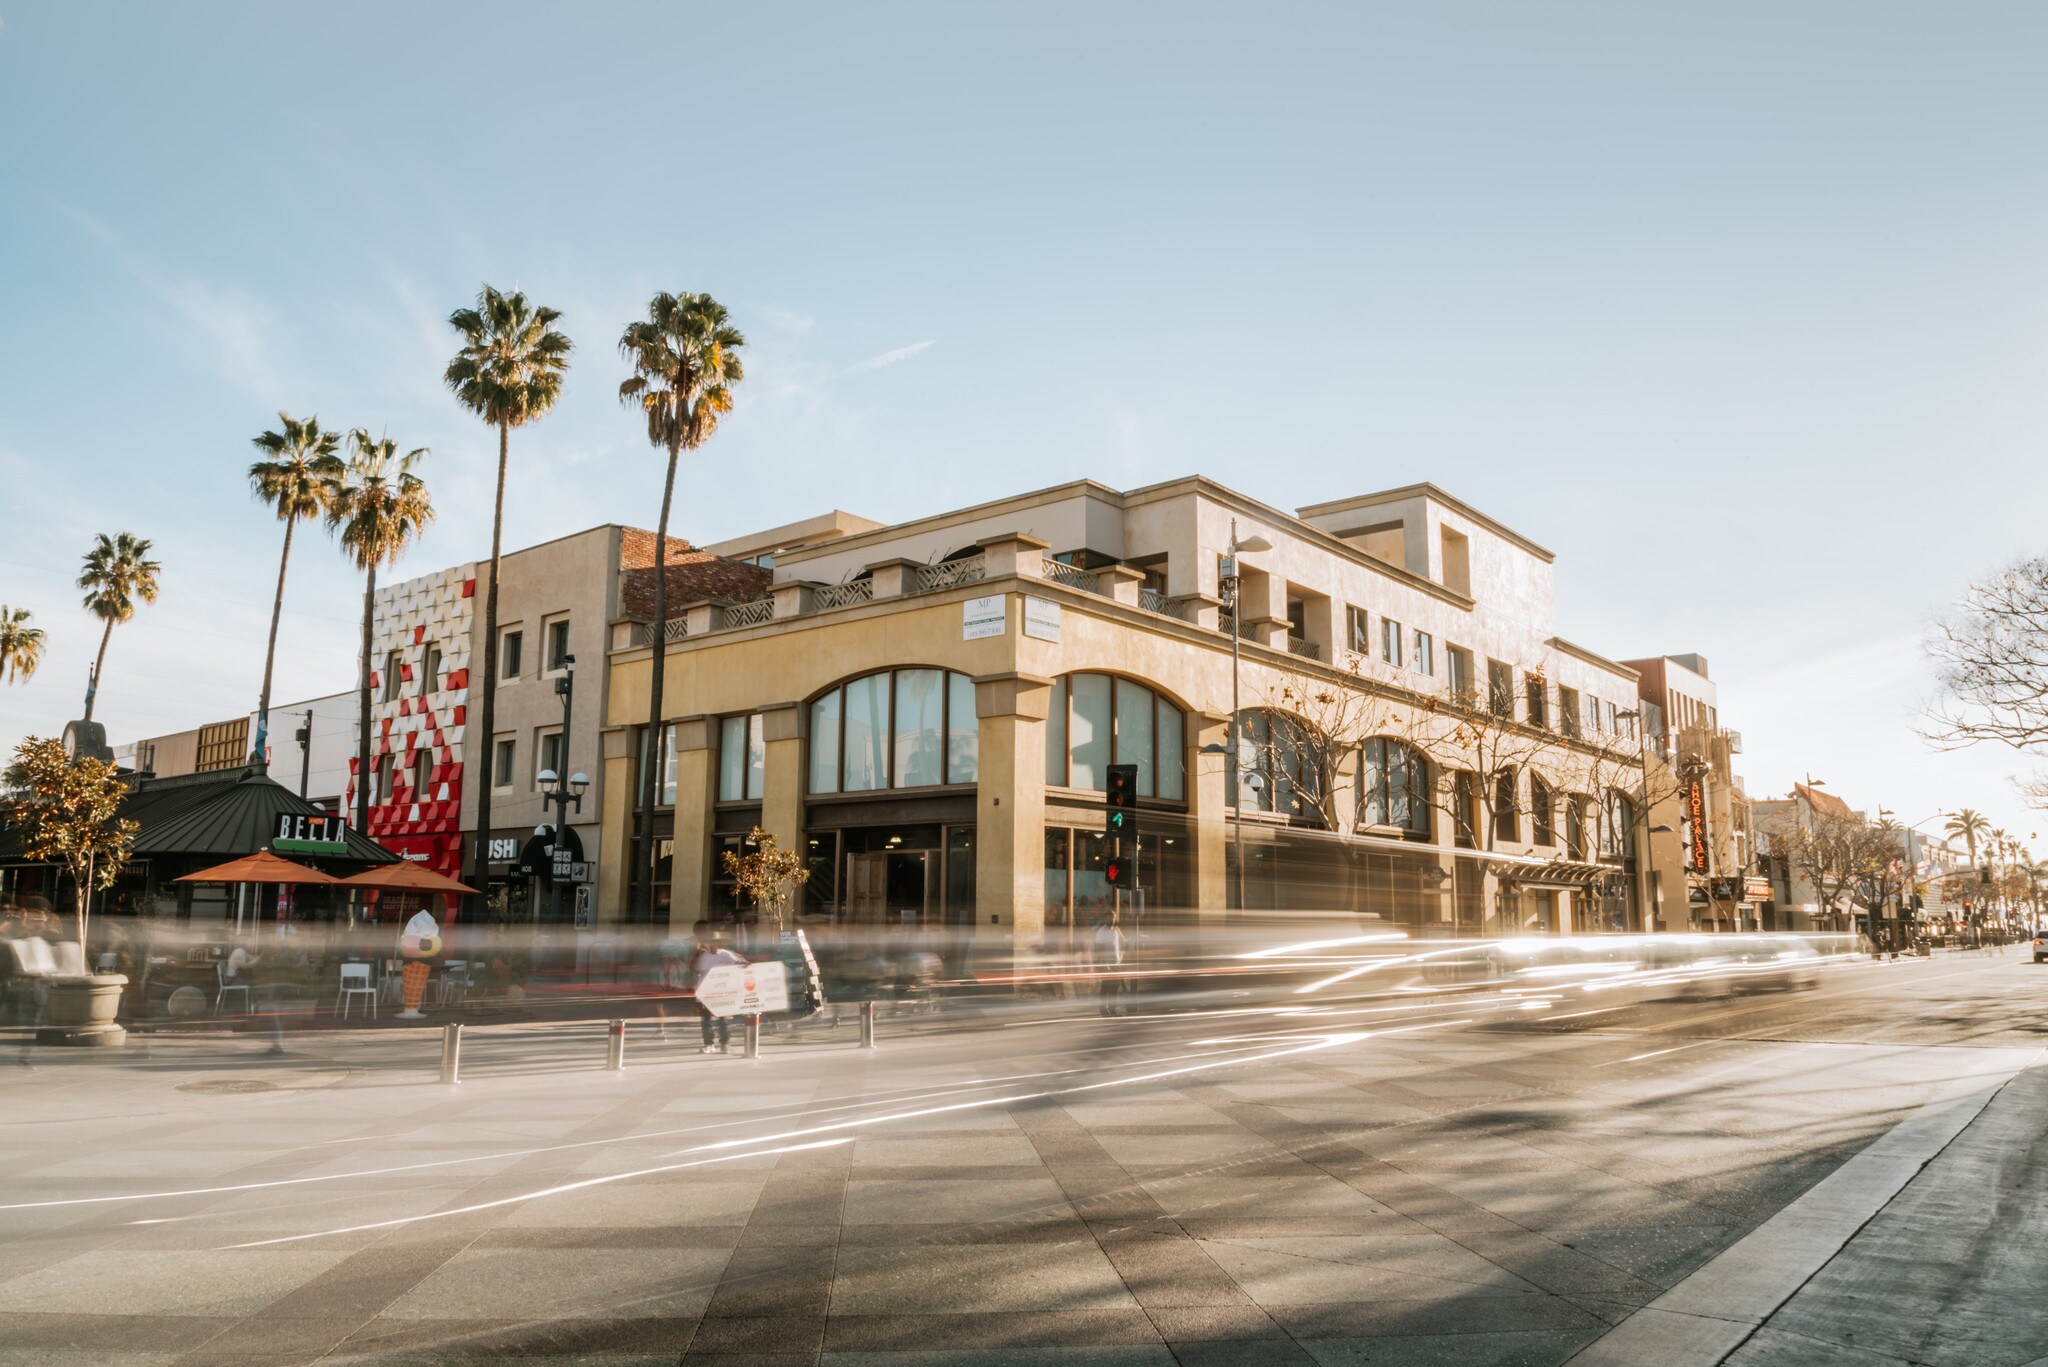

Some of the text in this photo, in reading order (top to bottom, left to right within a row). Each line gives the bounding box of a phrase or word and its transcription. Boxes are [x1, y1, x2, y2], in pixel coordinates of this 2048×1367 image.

[978, 599, 991, 609] MP
[280, 815, 345, 842] BELLA
[1691, 781, 1705, 869] SHOE PALACE
[475, 838, 517, 859] USH
